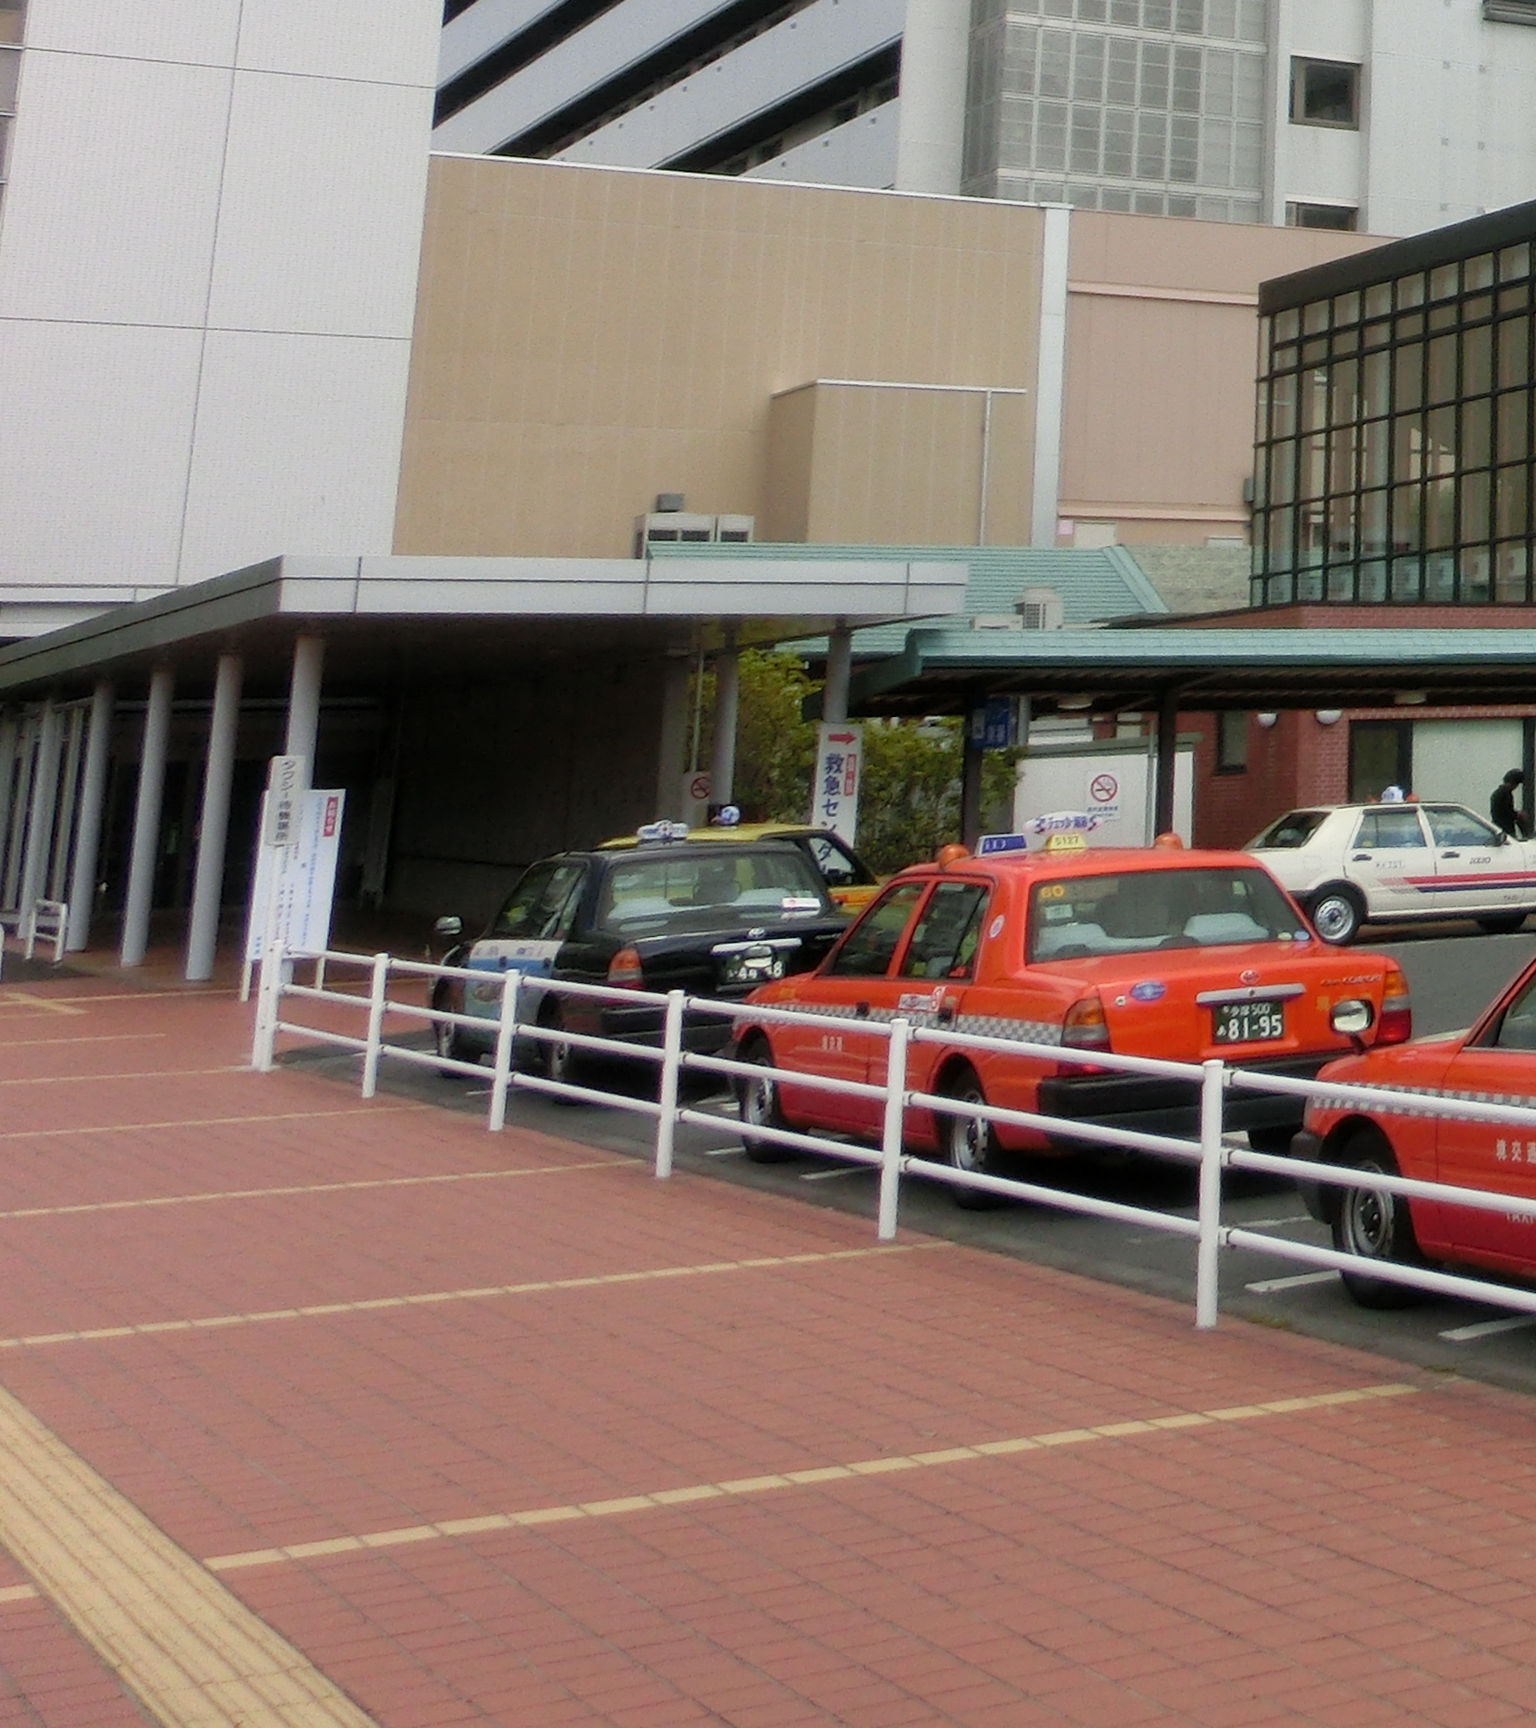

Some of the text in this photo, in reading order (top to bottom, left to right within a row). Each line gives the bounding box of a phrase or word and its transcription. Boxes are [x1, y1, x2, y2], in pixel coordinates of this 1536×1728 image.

[818, 752, 845, 864] 救急センタ
[1251, 1002, 1271, 1015] 500
[1228, 1014, 1283, 1041] 81-95
